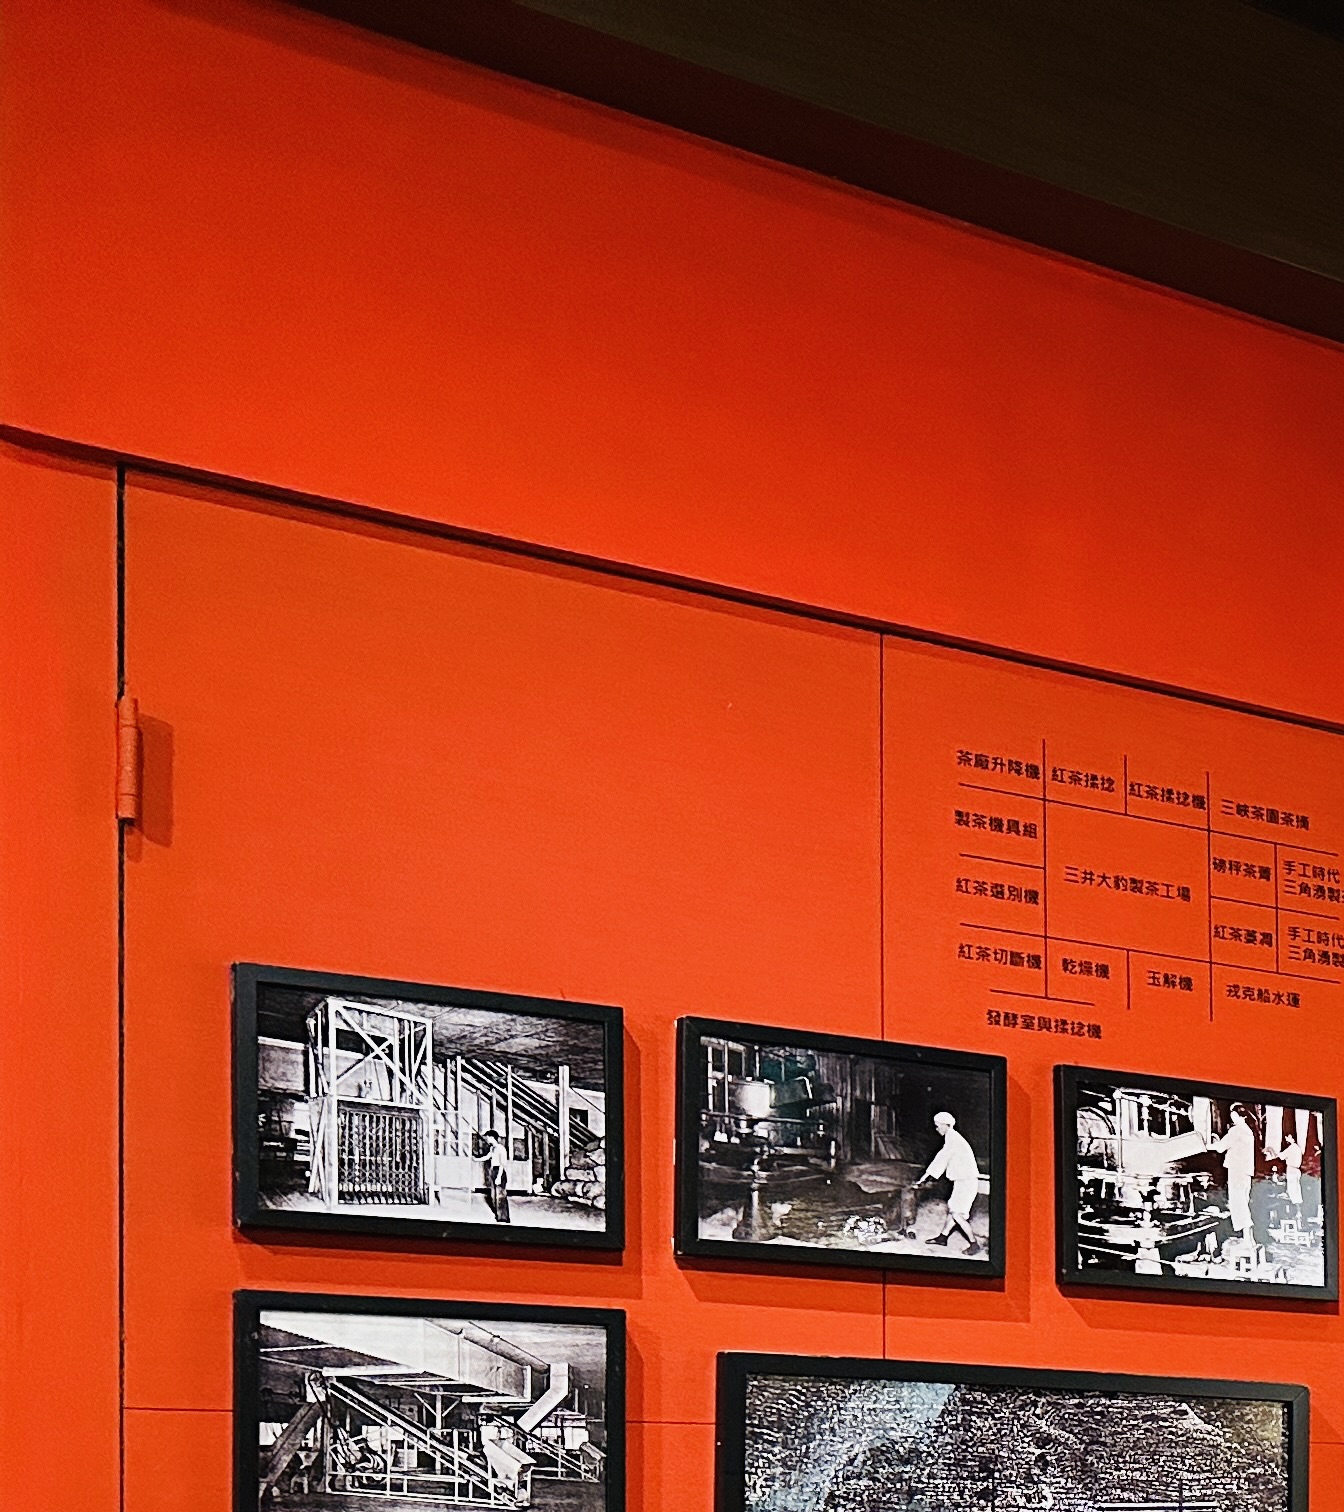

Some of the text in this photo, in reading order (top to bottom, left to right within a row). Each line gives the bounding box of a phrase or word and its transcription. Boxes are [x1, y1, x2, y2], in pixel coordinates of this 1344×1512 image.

[956, 749, 1041, 780] 茶廠升降機
[1051, 766, 1116, 793] 紅茶揉捻
[954, 809, 1038, 839] 製茶機具組
[1063, 865, 1191, 903] 三井大豹製茶工場
[1283, 859, 1341, 884] 手工時代
[955, 877, 1040, 906] 紅茶選別機
[1287, 926, 1344, 949] 手工時代
[957, 942, 1042, 971] 紅茶切斷機
[1061, 957, 1110, 980] 乾燥機
[1146, 970, 1194, 992] 玉解機
[1225, 983, 1301, 1009] 戎克船水運
[986, 1008, 1102, 1040] 發酵室與揉捻機
